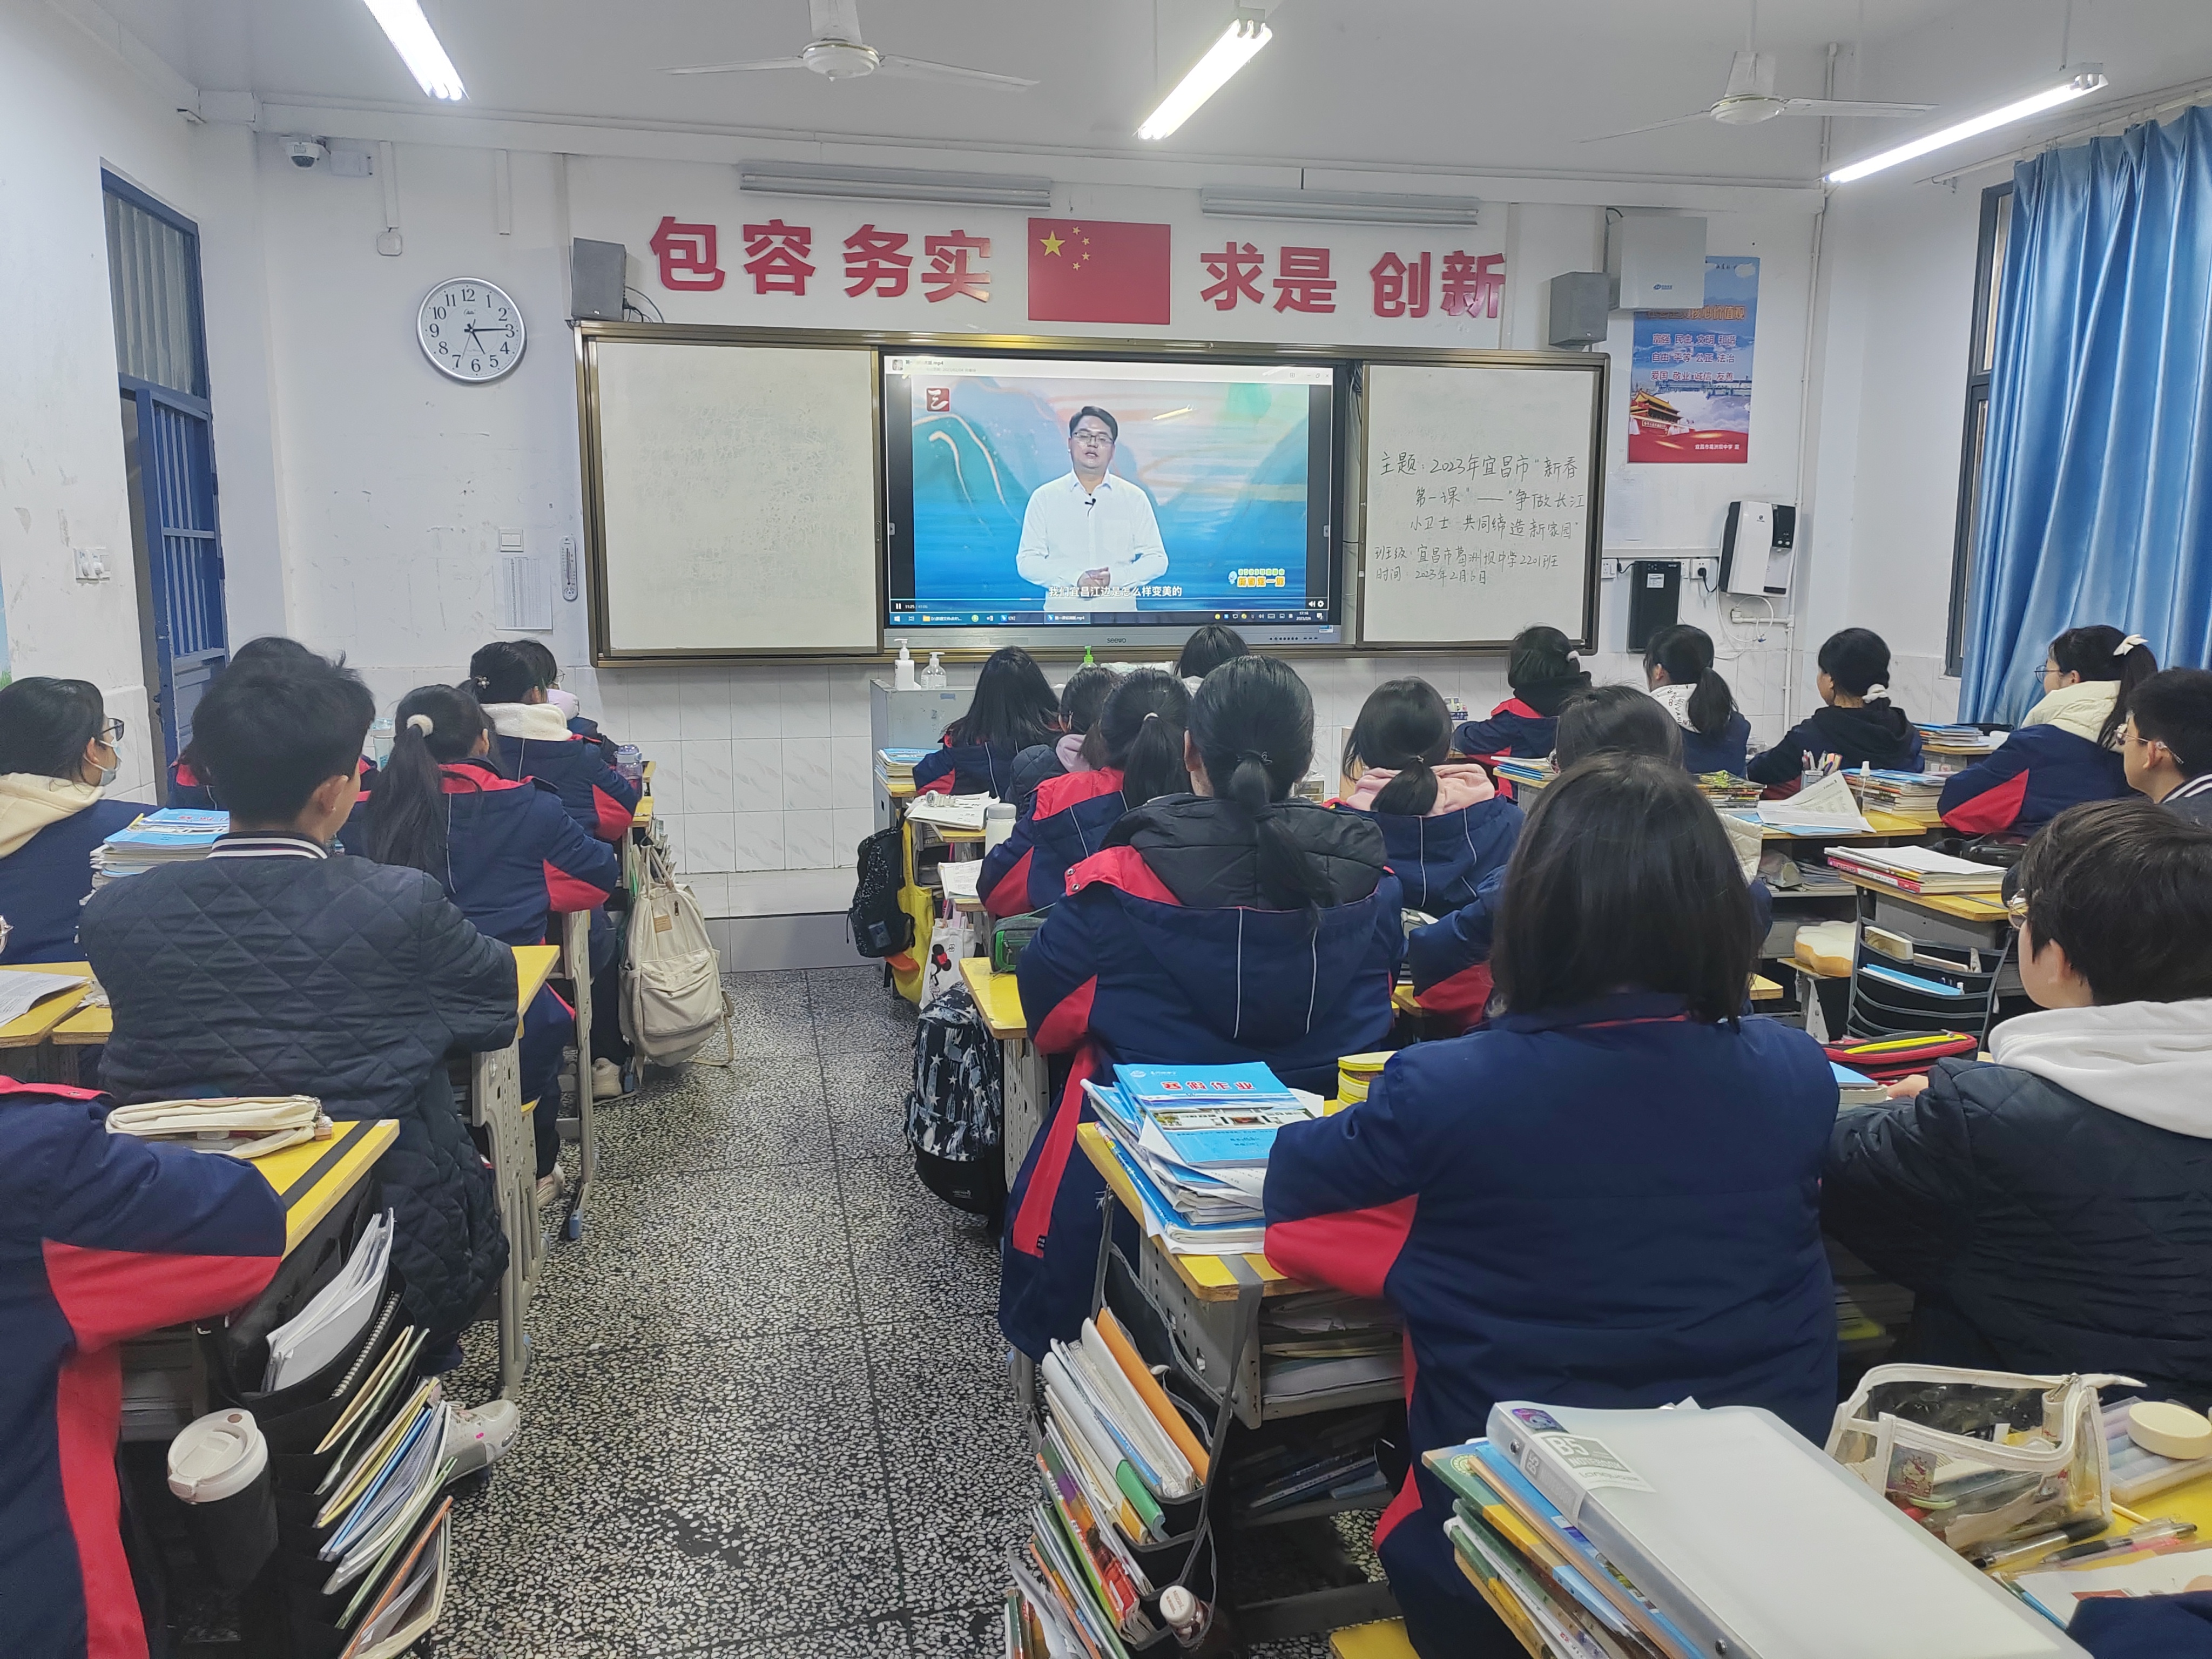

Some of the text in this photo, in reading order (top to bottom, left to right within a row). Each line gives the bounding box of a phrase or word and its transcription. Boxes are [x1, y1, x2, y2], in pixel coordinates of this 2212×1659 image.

[650, 216, 991, 303] 包容 务实
[1200, 241, 1506, 319] 求是 创新
[446, 294, 456, 307] 11
[461, 288, 475, 301] 12
[486, 294, 491, 308] 1
[433, 306, 447, 320] 10
[498, 307, 508, 321] 2
[429, 323, 440, 338] 9
[505, 323, 515, 338] 3
[1653, 334, 1736, 346] 富强 民主 文明 和谐
[439, 341, 448, 354] 8
[500, 341, 510, 354] 4
[452, 355, 461, 368] 7
[490, 355, 498, 368] 5
[1652, 353, 1735, 363] 自由 平等 公正 法治
[471, 359, 481, 372] 6
[1651, 371, 1734, 381] 爱国 敬业 诚信 友善
[1049, 585, 1182, 597] 我们宜昌江边是怎么样变美的
[1547, 1436, 1589, 1456] B5
[1568, 1458, 1627, 1471] NOTEBOOK
